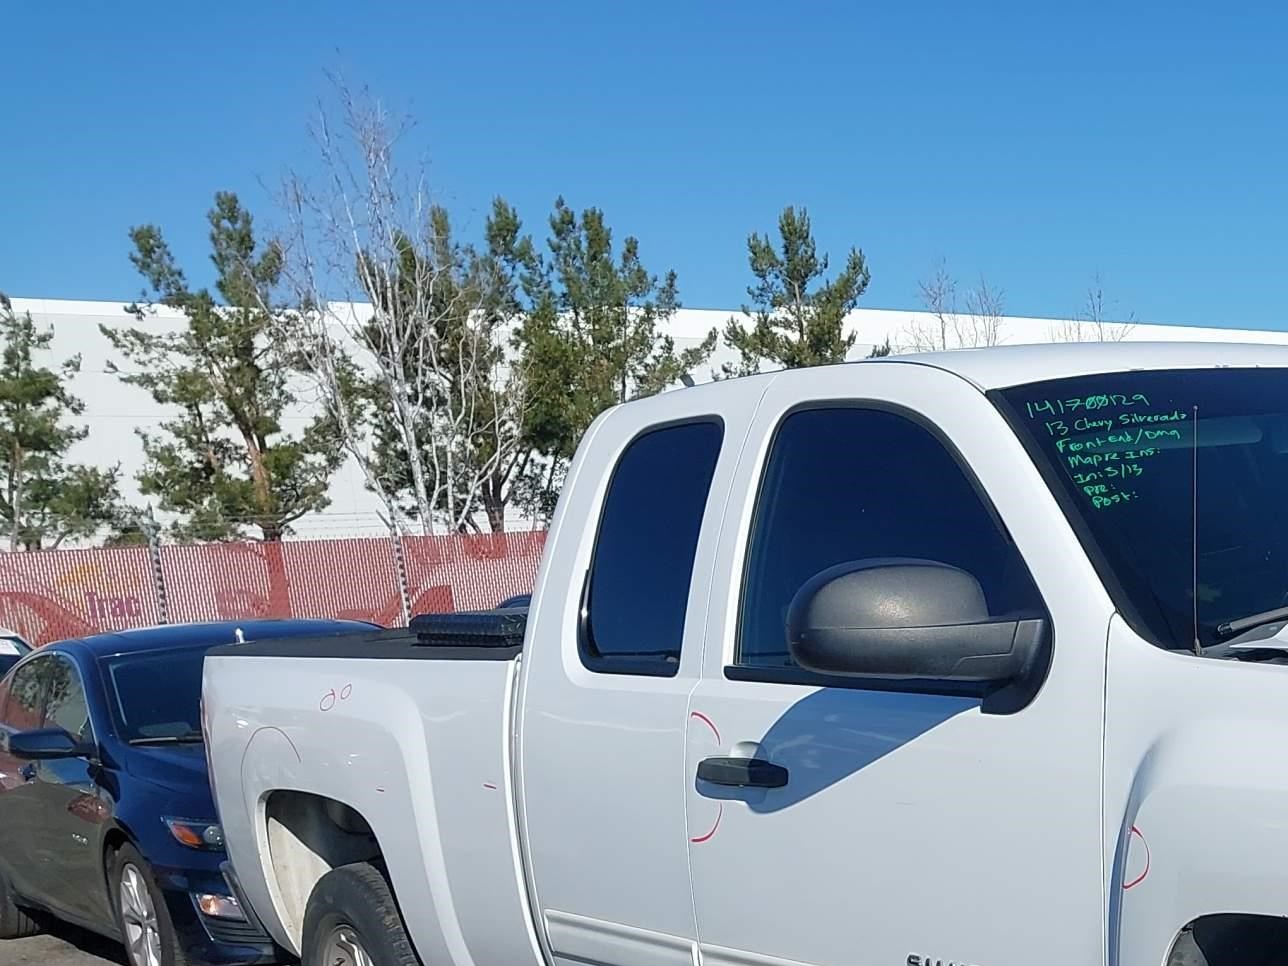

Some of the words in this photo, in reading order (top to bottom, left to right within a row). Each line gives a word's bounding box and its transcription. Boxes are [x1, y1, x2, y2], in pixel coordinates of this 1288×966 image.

[1046, 421, 1069, 436] 13
[1074, 417, 1113, 432] Chevy
[1118, 410, 1188, 425] Silverado
